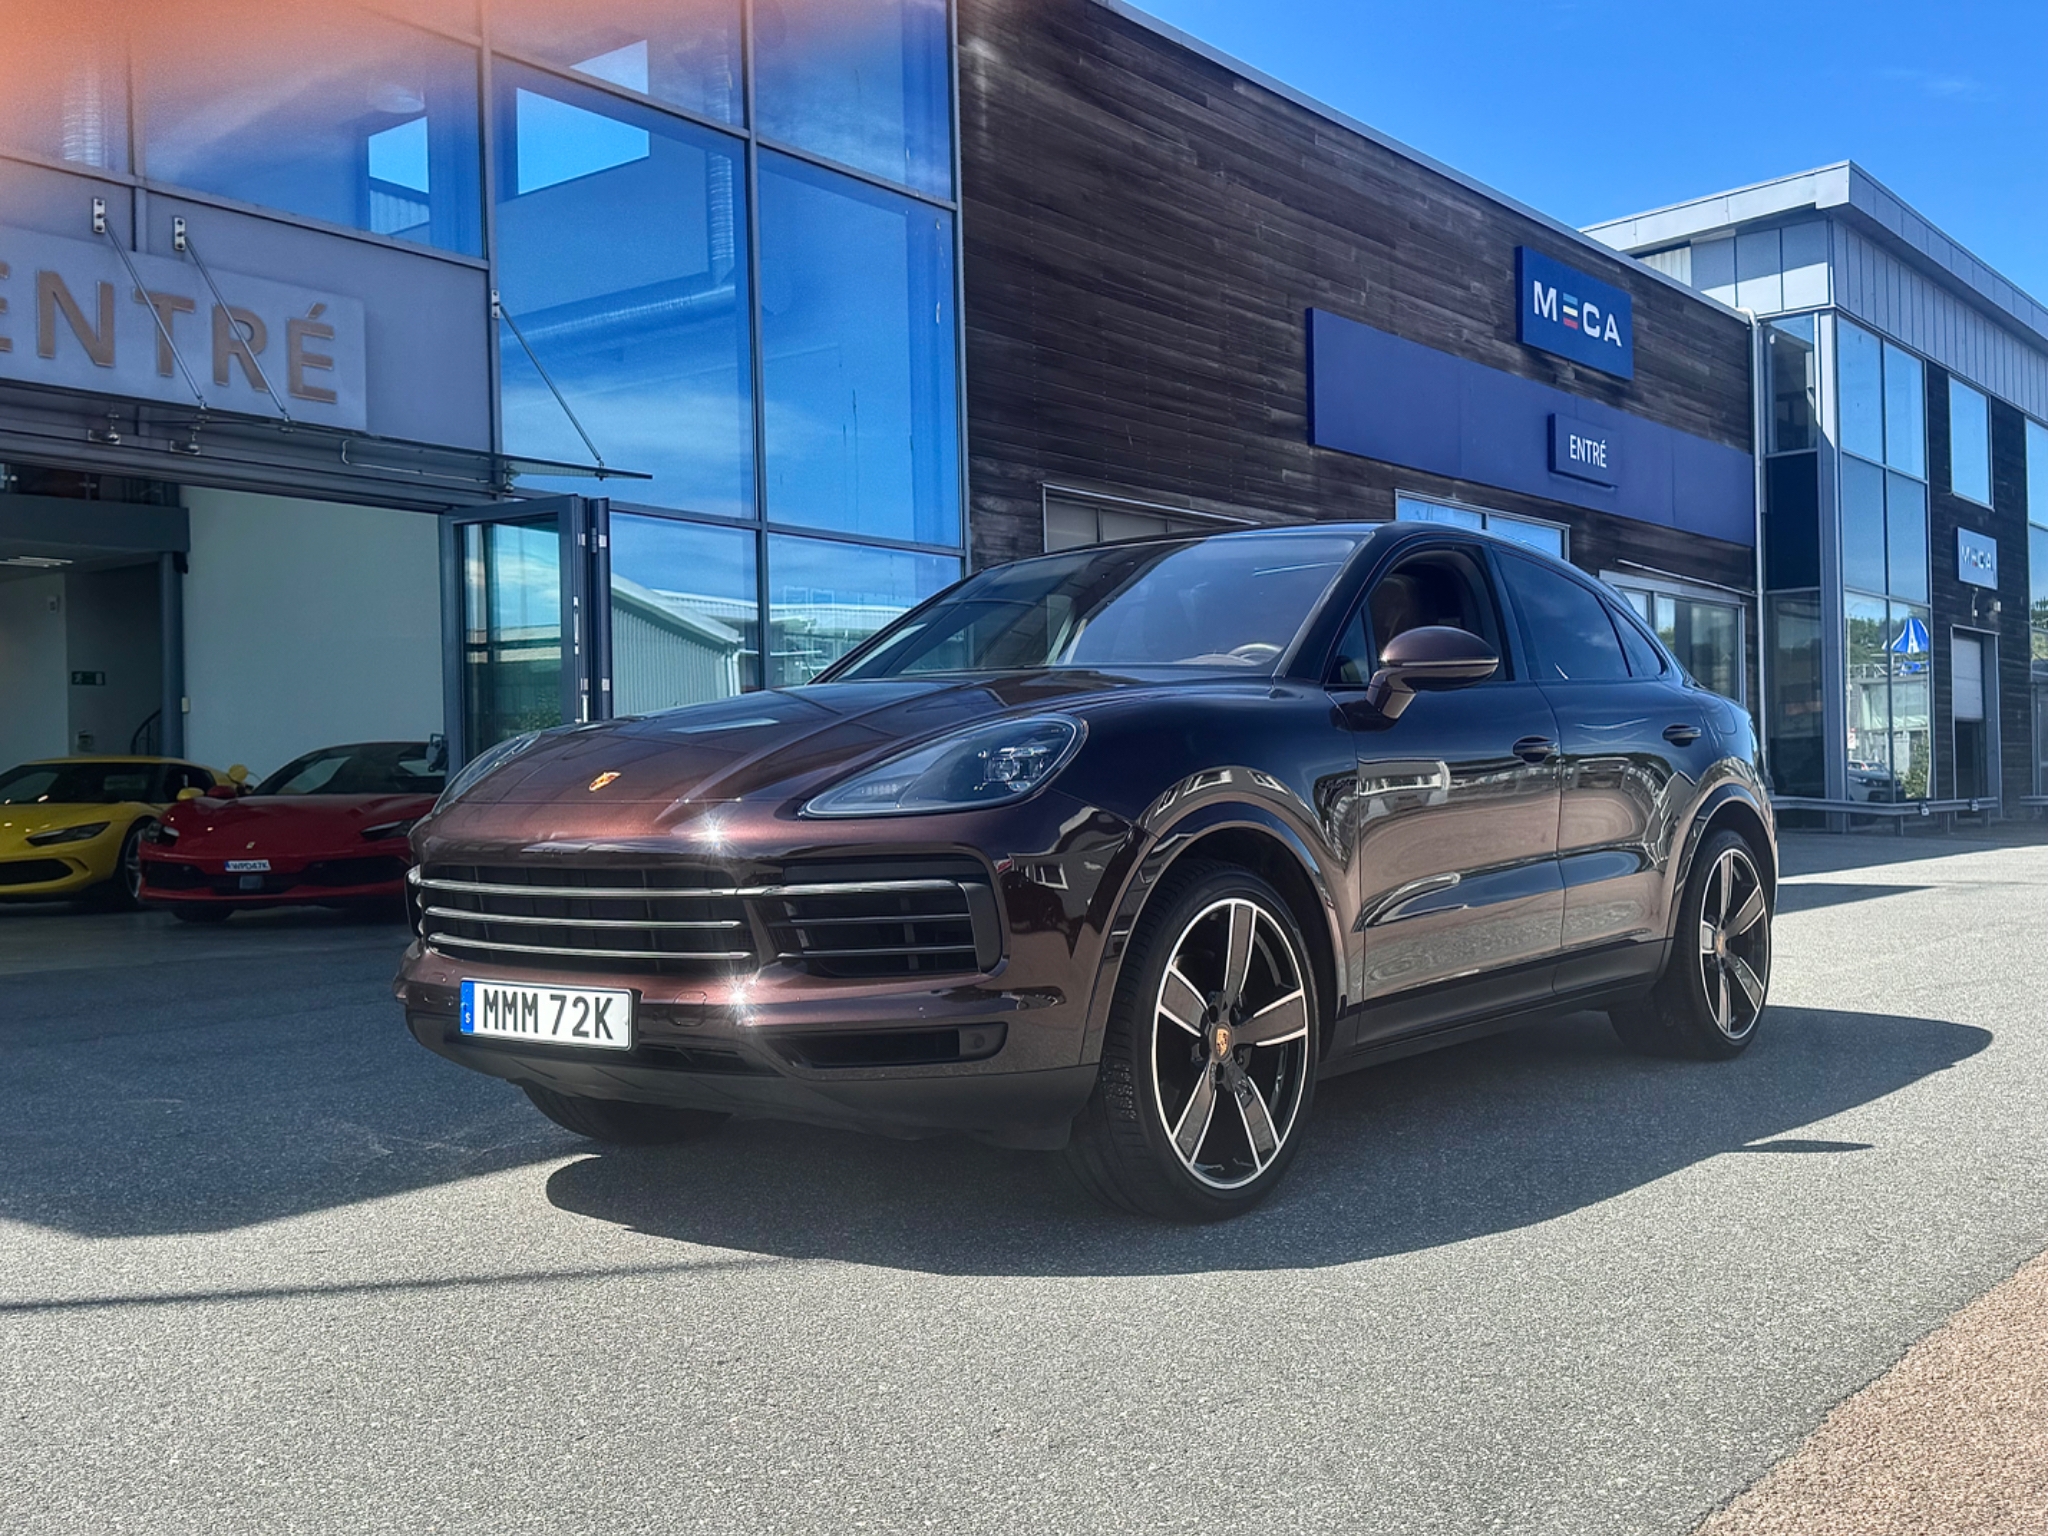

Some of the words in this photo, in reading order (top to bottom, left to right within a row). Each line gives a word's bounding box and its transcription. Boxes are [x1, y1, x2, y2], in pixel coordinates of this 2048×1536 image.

[0, 261, 337, 403] NTRÉ
[1533, 281, 1622, 347] MECA
[1570, 434, 1607, 469] ENTRÉ
[484, 988, 539, 1034] MMM
[550, 994, 614, 1040] 72K
